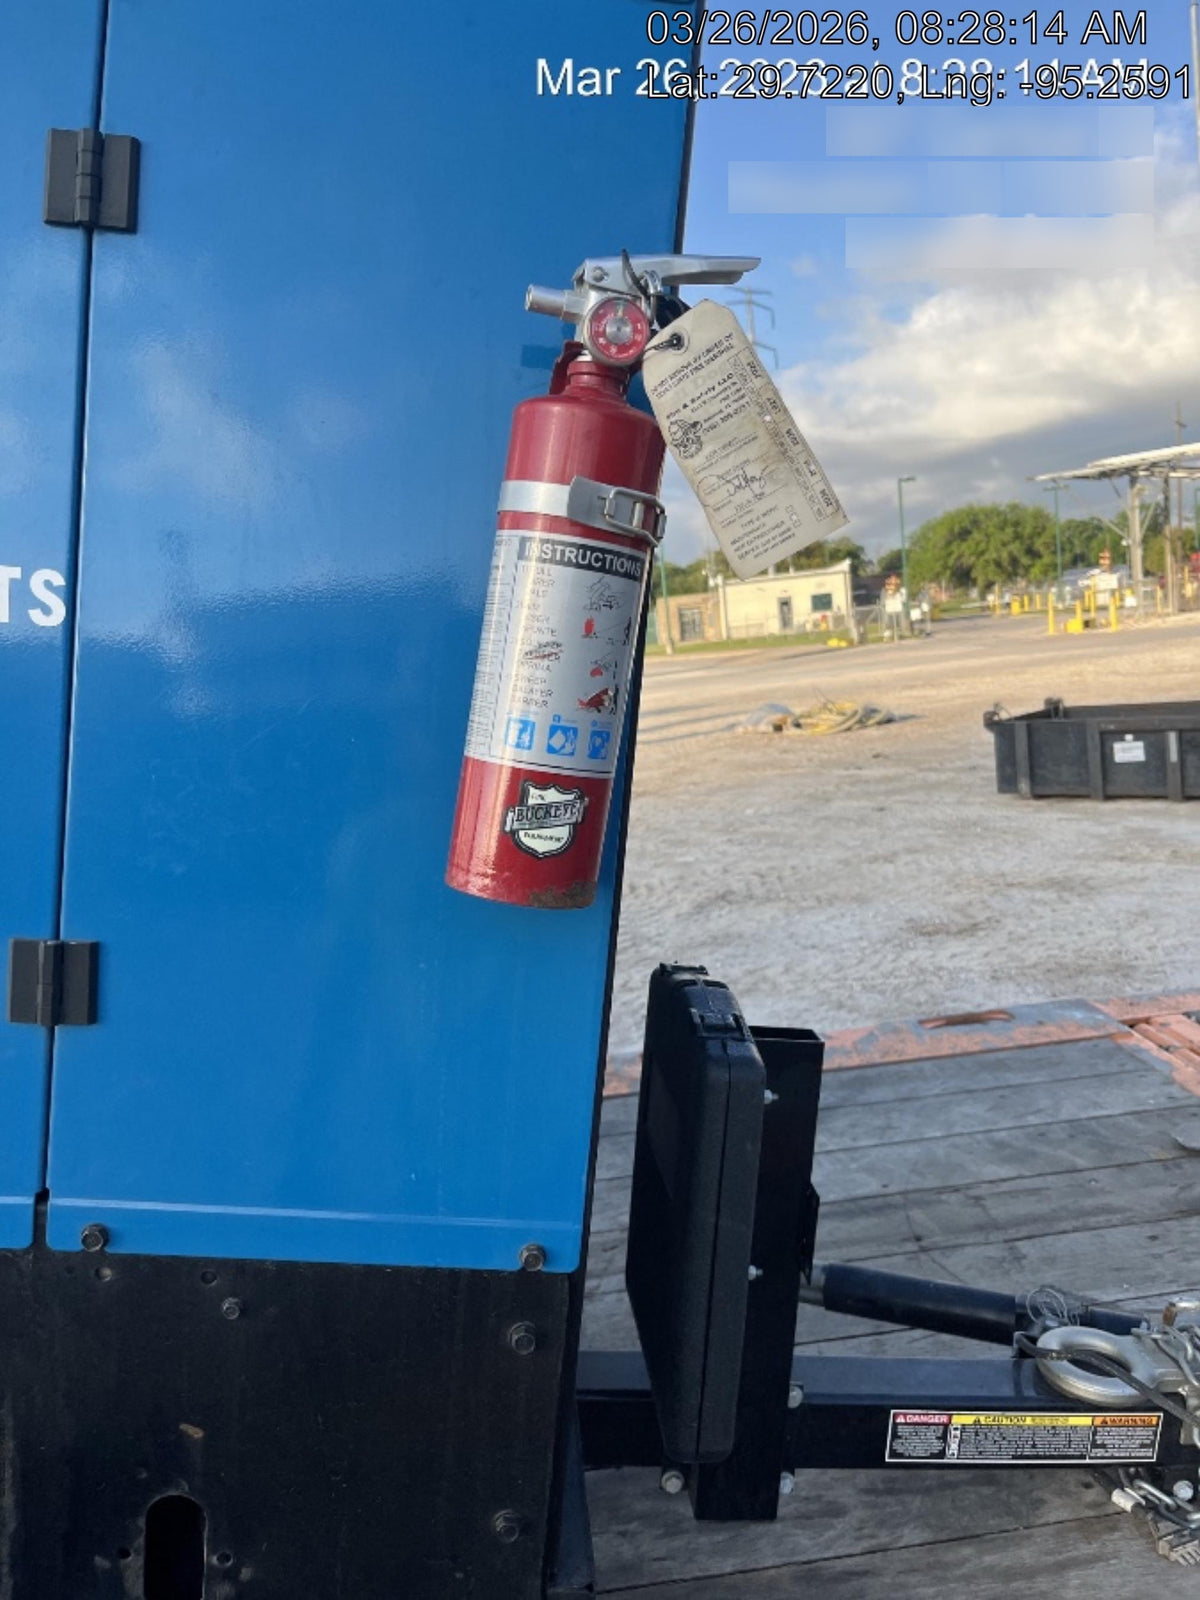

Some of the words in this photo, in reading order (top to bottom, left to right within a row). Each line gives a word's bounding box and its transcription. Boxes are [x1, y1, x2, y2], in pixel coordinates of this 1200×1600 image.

[525, 541, 641, 577] INSTRUCTIONS
[906, 1414, 949, 1424] DANGER
[985, 1416, 1026, 1424] CAUTION
